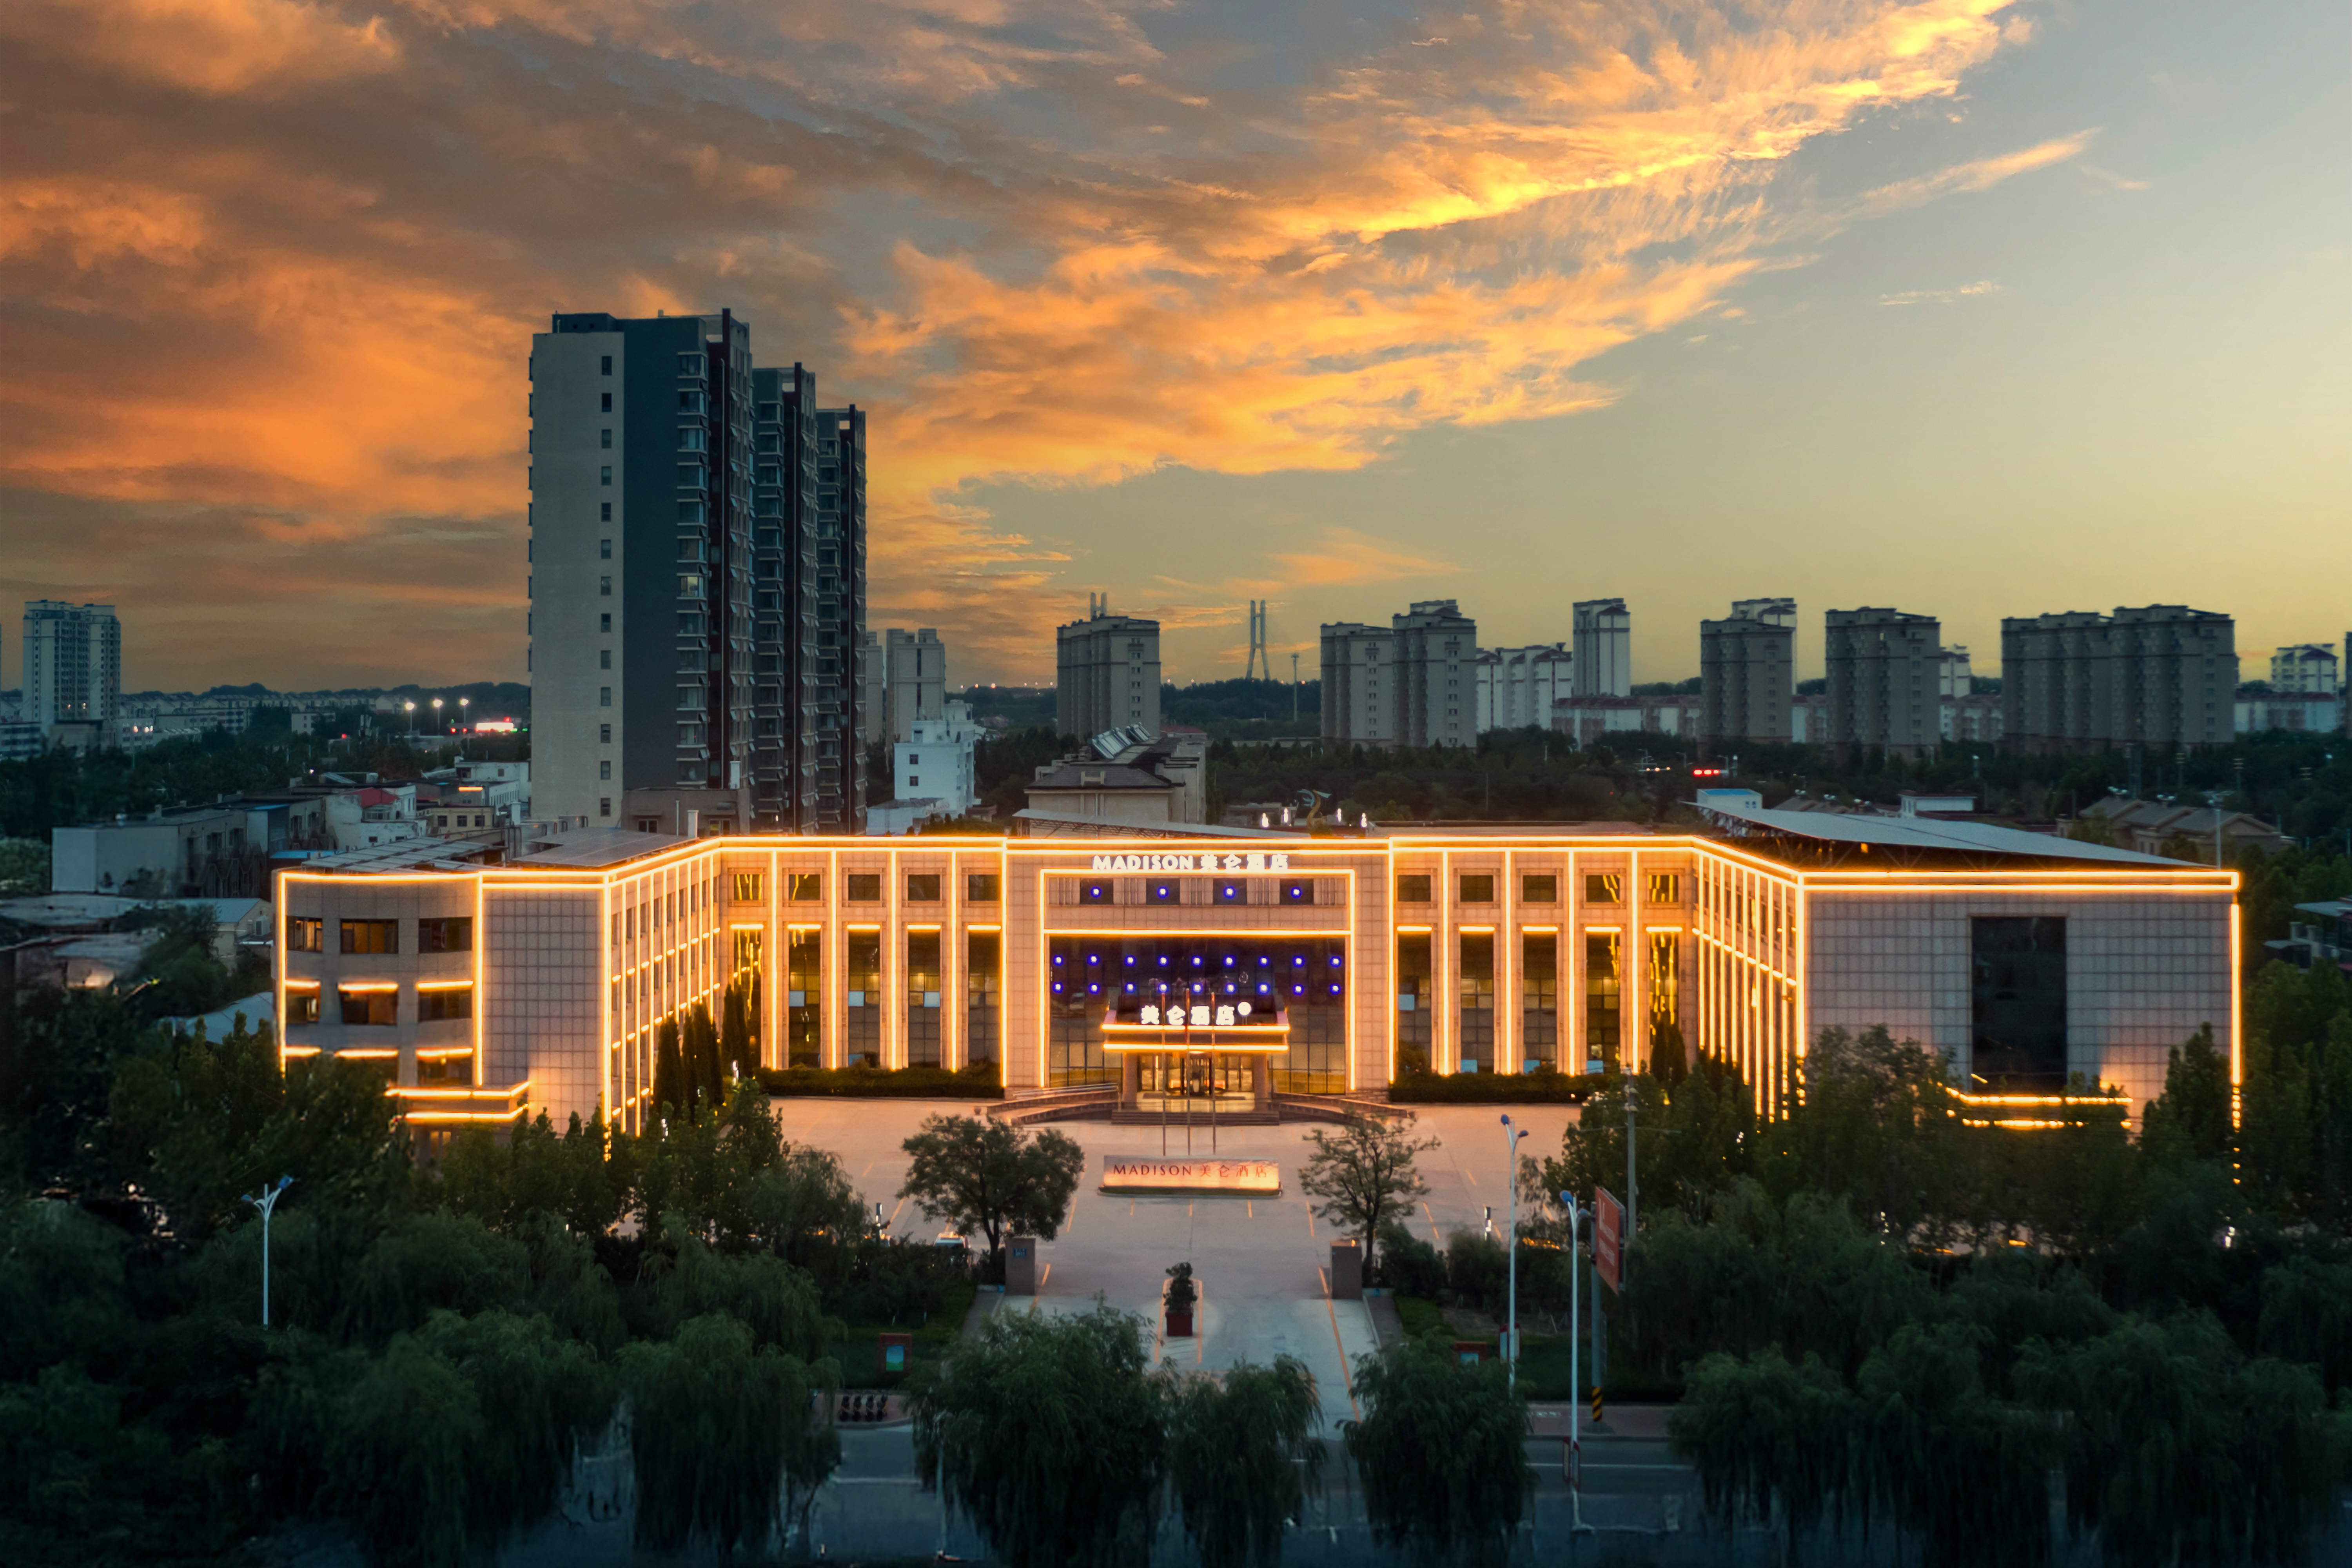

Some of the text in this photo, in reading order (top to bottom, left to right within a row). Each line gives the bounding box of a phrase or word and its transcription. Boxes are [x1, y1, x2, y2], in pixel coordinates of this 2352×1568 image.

[1093, 855, 1193, 870] MADISON
[1113, 1164, 1267, 1178] MADISON 美仑酒店
